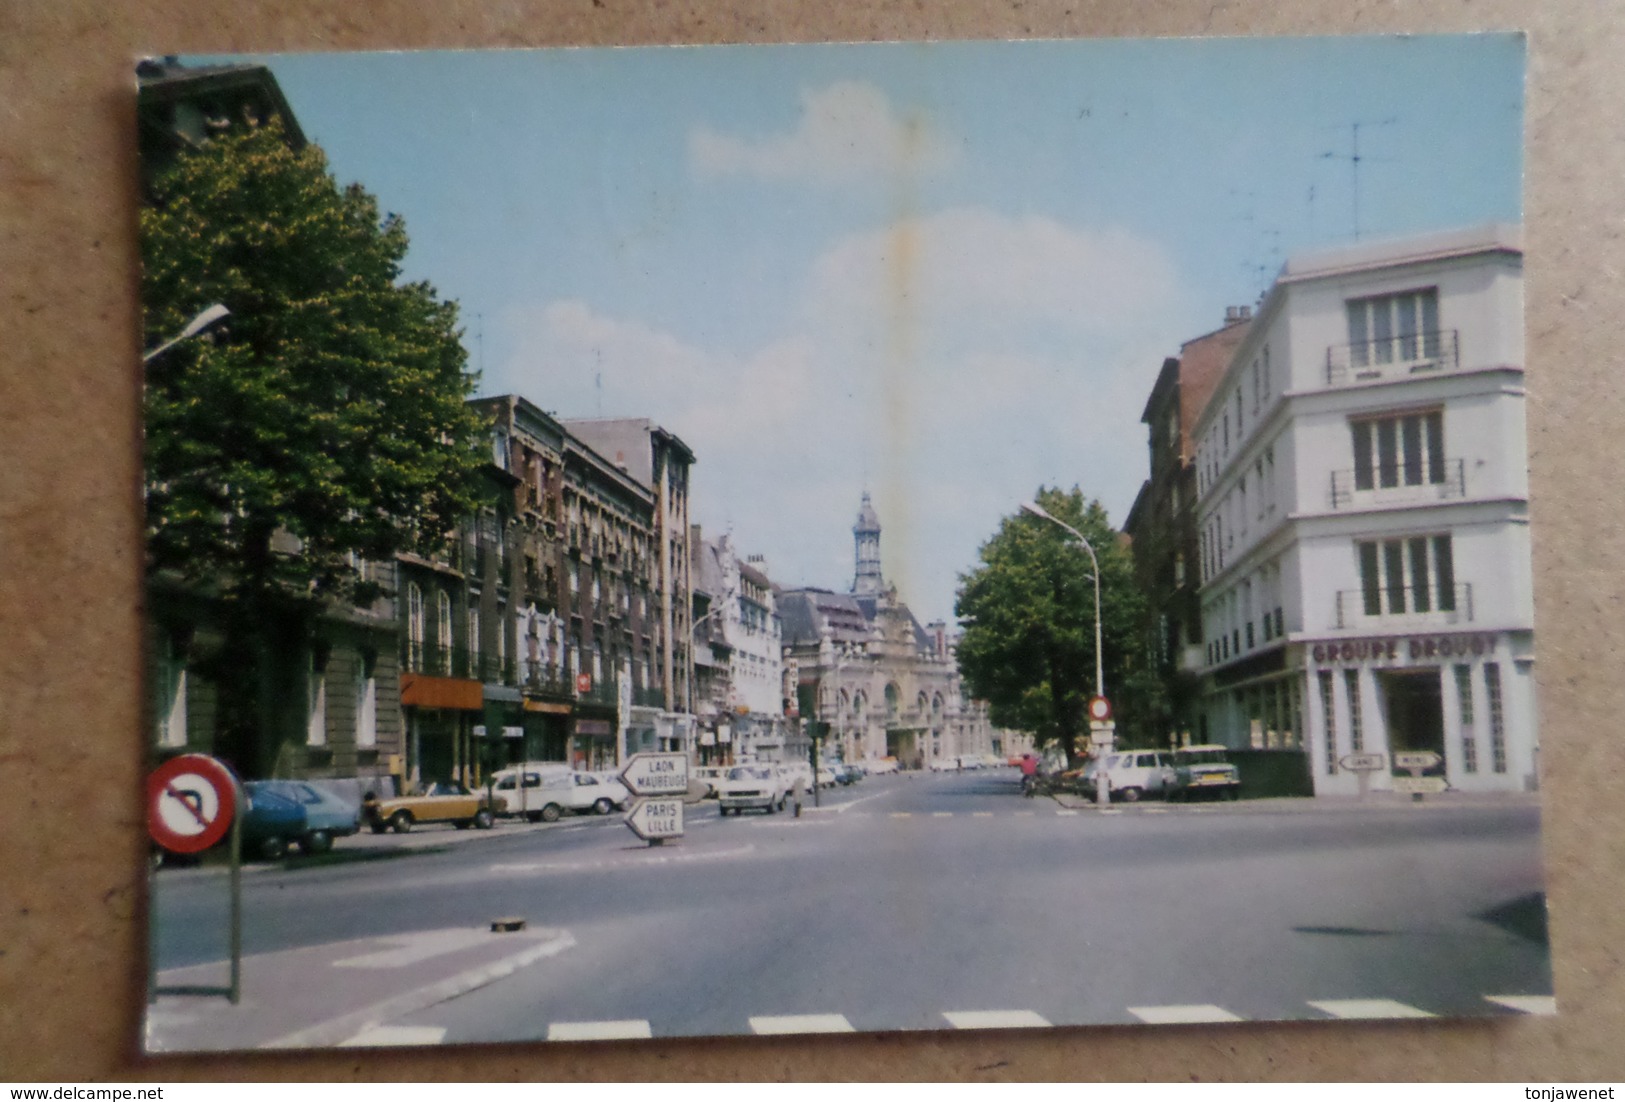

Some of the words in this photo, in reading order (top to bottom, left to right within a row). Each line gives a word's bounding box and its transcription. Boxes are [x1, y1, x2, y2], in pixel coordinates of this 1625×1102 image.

[1313, 640, 1397, 662] GROUPE
[649, 760, 675, 772] LAON
[637, 775, 686, 787] MAUBEUGE
[646, 804, 677, 816] PARIS
[648, 820, 675, 832] LILLE
